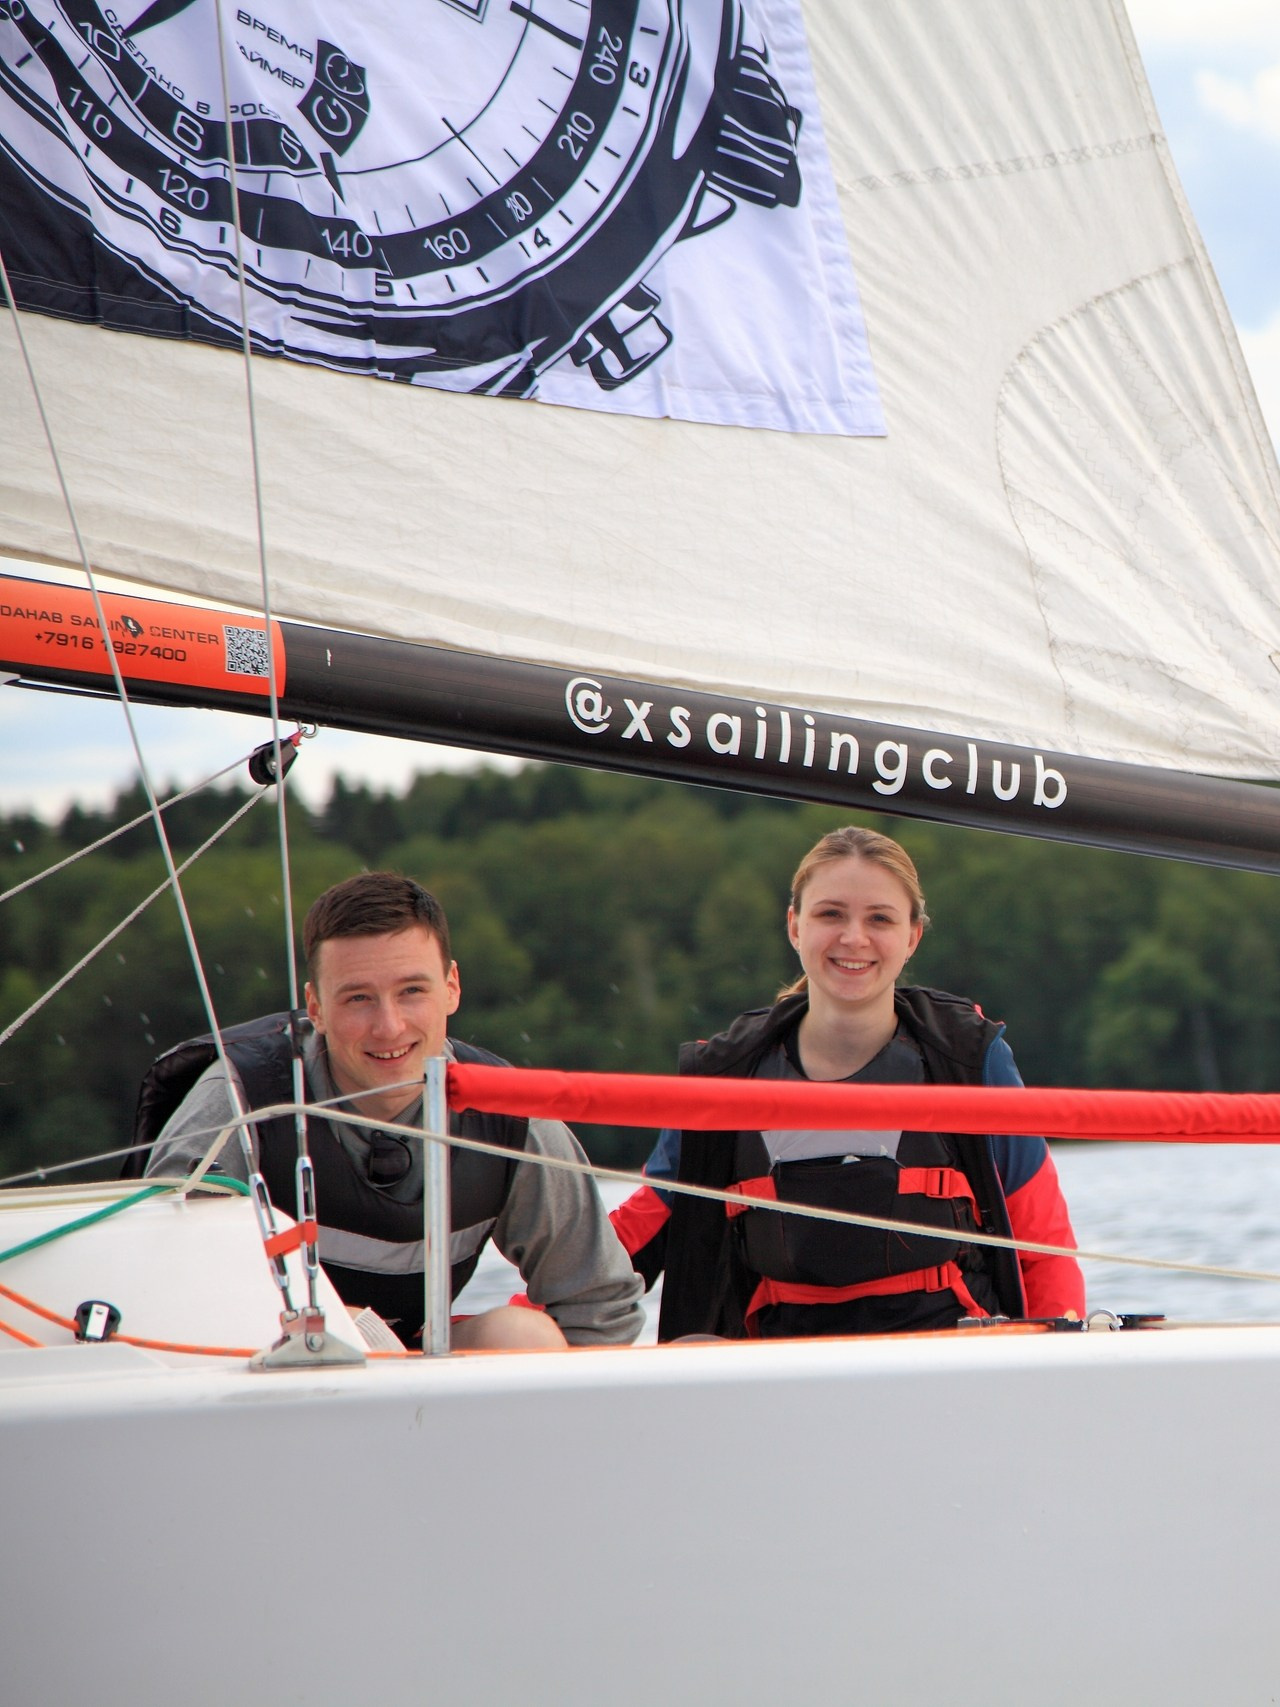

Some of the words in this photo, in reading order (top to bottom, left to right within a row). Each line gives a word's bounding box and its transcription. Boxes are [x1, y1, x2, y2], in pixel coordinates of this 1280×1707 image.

[236, 9, 314, 64] ВРЕМЯ
[588, 25, 623, 85] 240
[236, 40, 306, 89] АЙМЕР
[628, 61, 651, 88] 3
[70, 86, 113, 139] 110
[172, 110, 205, 151] 6
[557, 111, 596, 161] 210
[158, 168, 209, 211] 120
[159, 206, 182, 235] 6
[533, 227, 552, 249] 4
[321, 228, 373, 258] 140
[423, 227, 471, 261] 160
[374, 271, 394, 297] 5
[0, 605, 63, 624] DAHAB
[149, 625, 220, 646] CENTER
[35, 631, 95, 650] +7916
[100, 639, 188, 662] 1927400
[564, 677, 1068, 809] @xsailingclub
